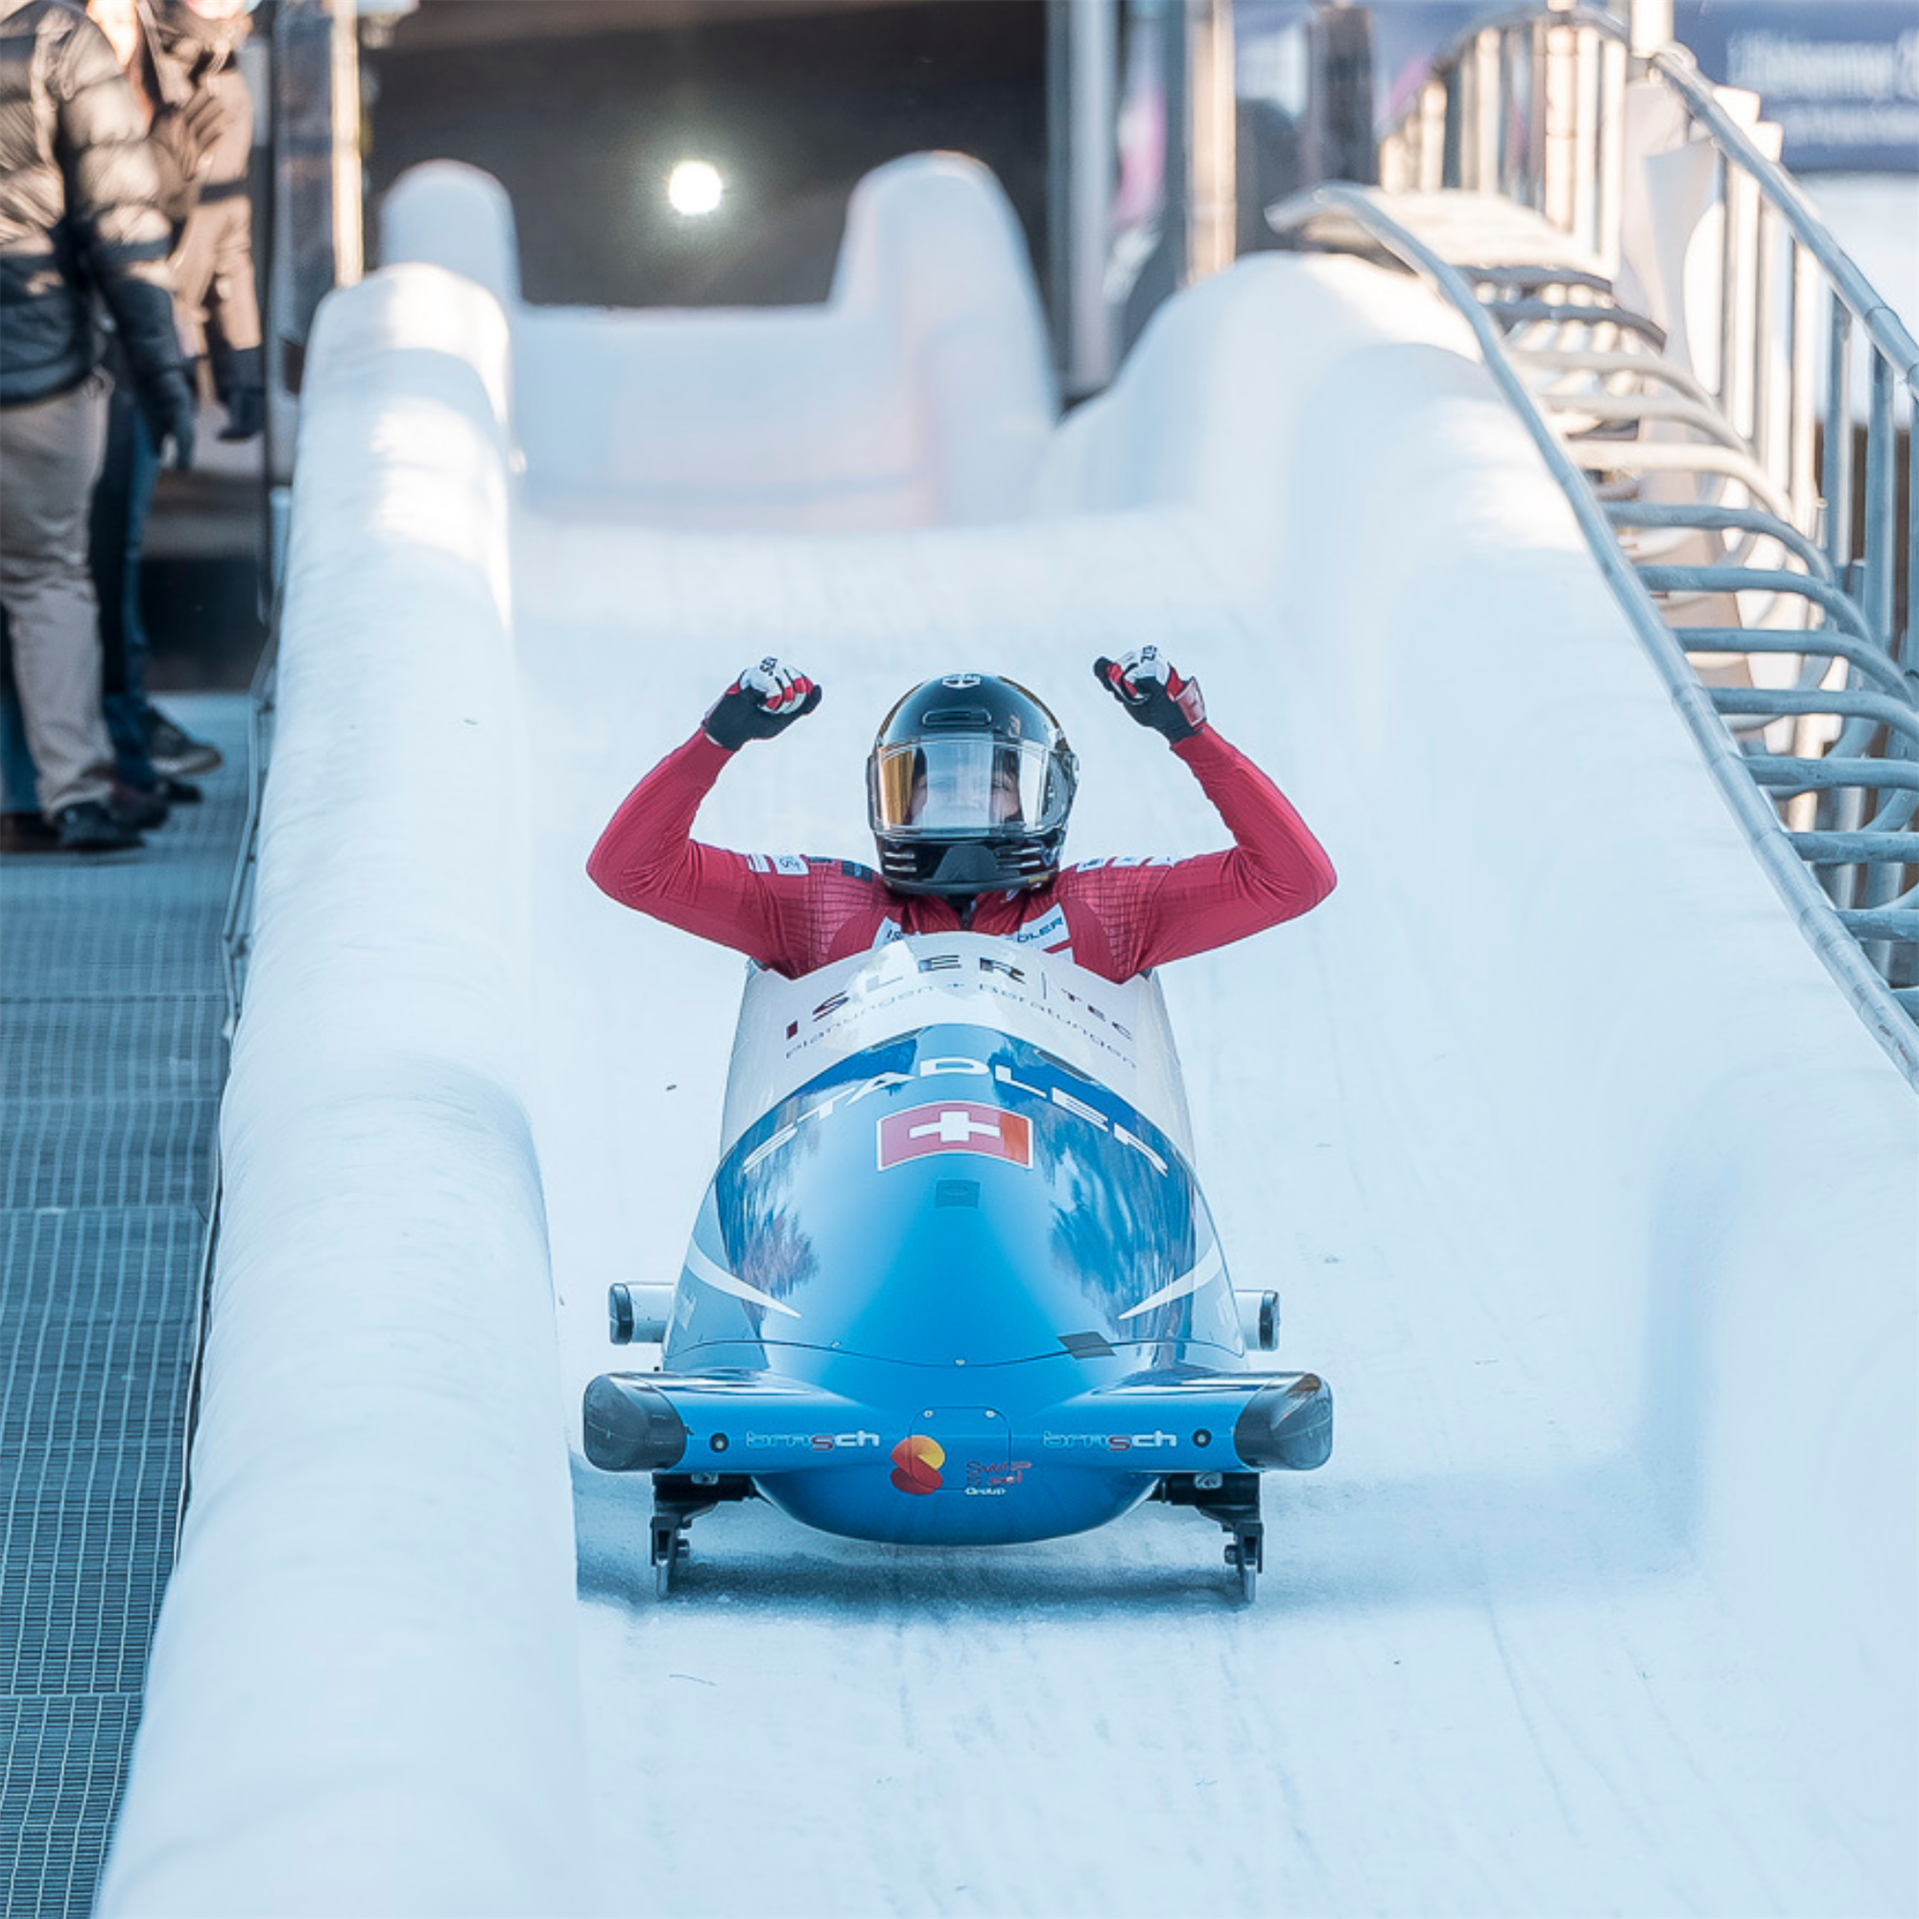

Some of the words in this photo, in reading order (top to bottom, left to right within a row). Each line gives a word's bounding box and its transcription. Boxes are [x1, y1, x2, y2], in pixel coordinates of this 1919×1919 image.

[1005, 917, 1064, 943] DLER
[786, 955, 1027, 1041] ISLER
[742, 1057, 1168, 1178] STADLER
